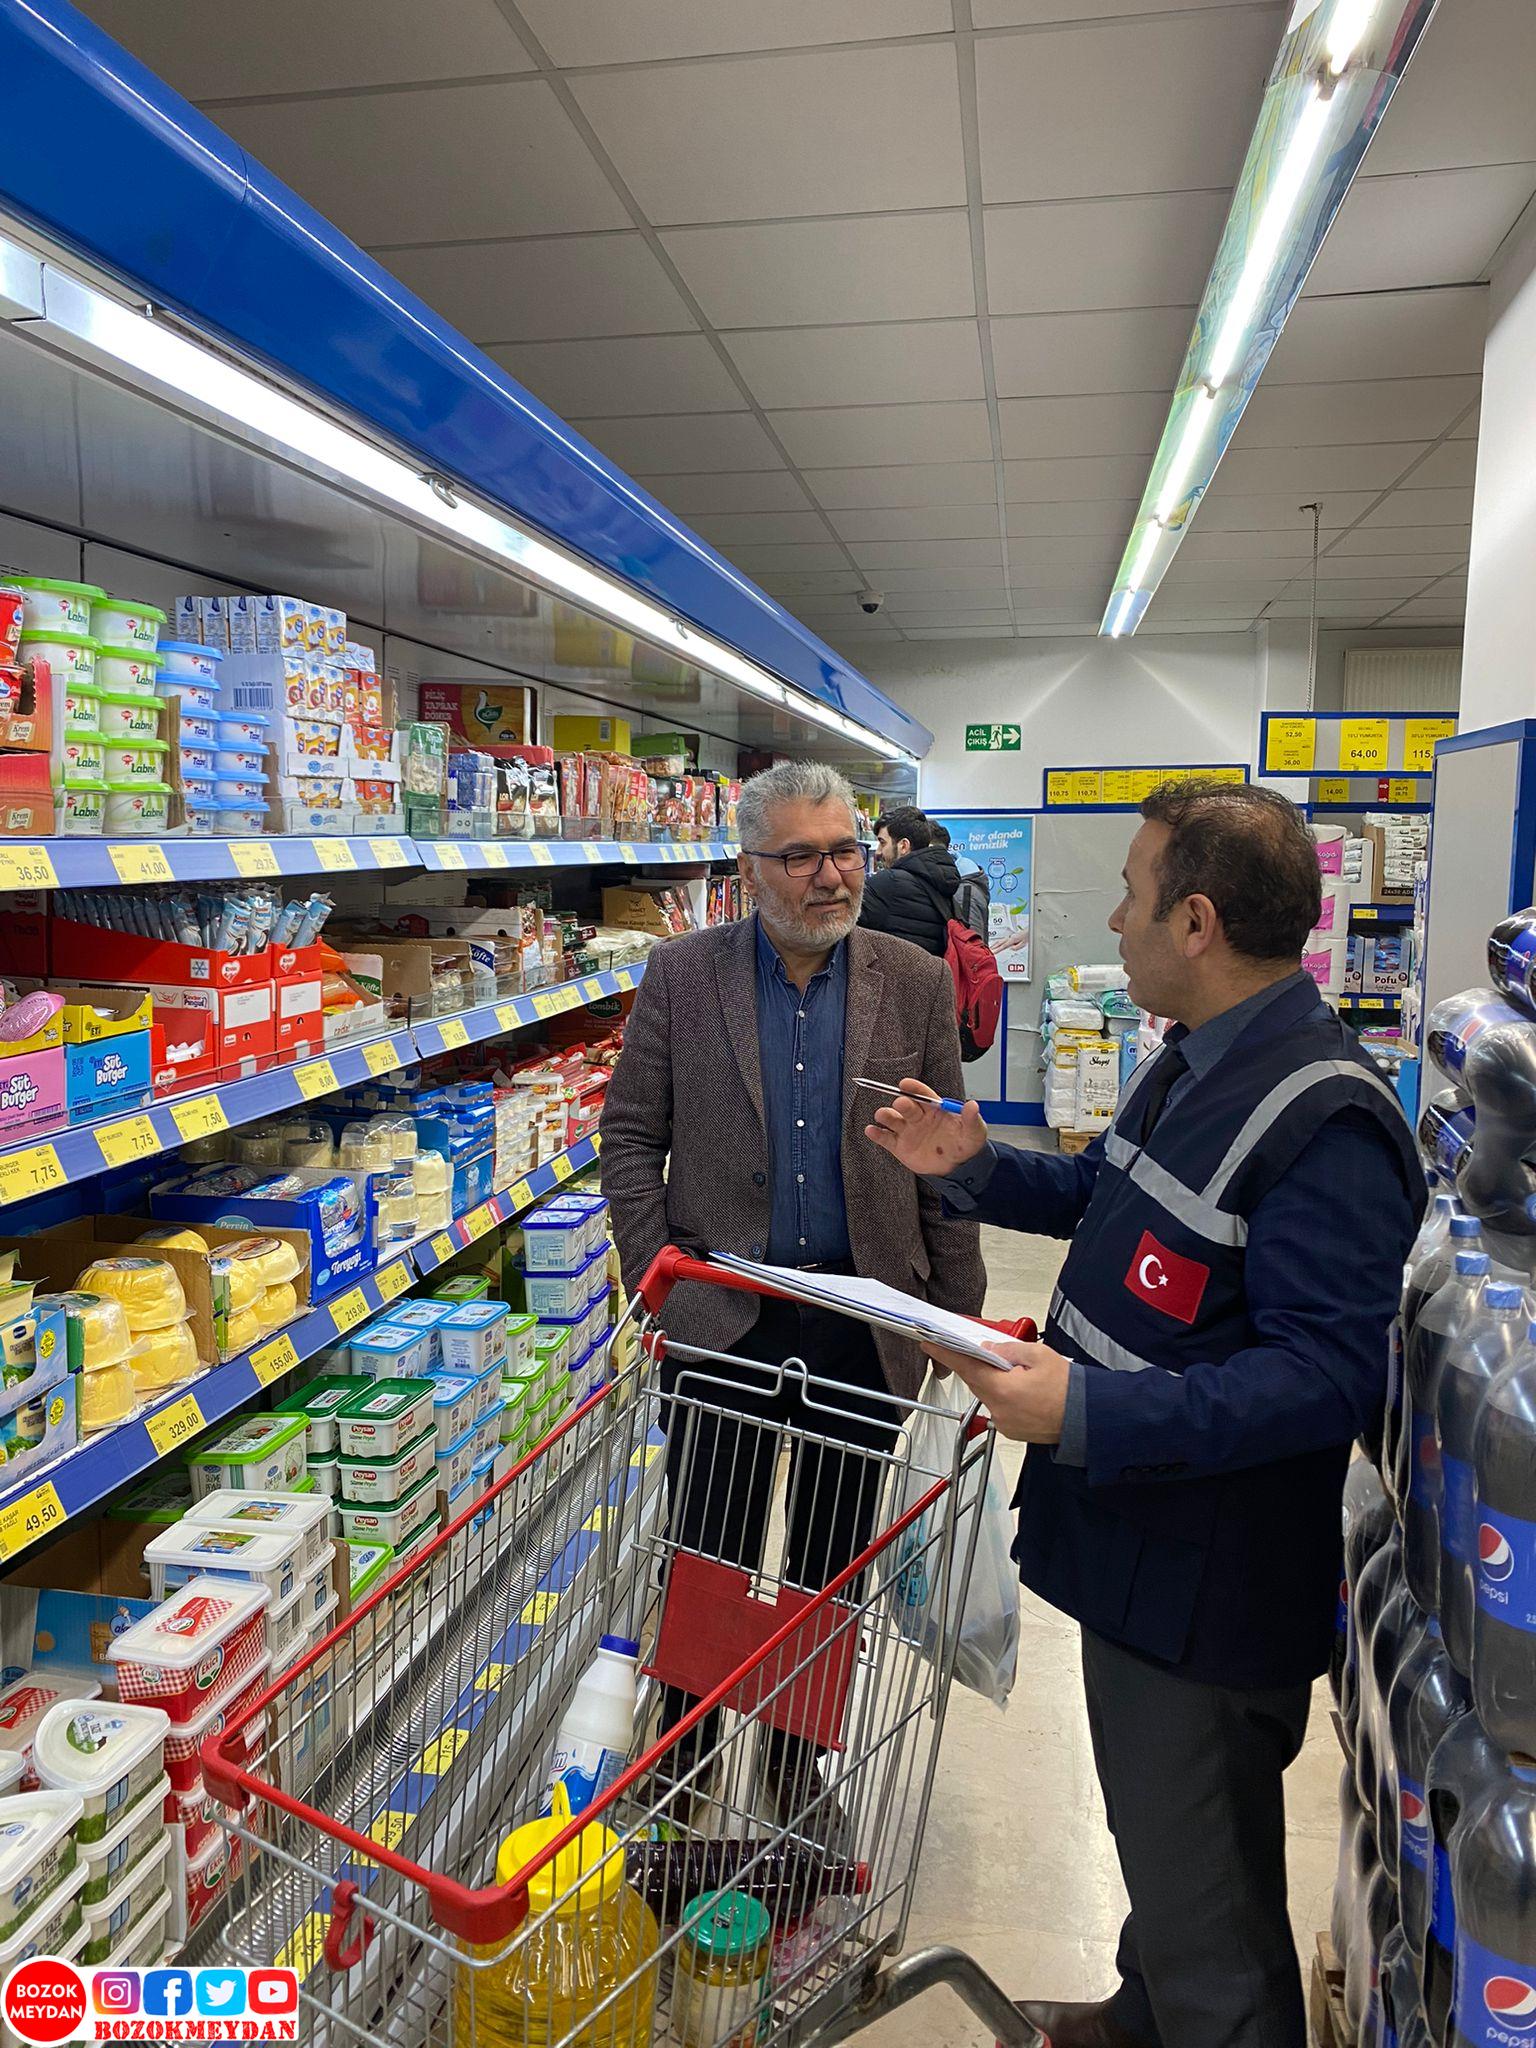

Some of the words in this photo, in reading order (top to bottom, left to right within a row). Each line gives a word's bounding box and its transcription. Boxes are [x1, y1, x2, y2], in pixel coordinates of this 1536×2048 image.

[968, 728, 987, 737] ACİL
[967, 738, 987, 747] ÇIKIŞ
[1350, 749, 1378, 759] 64,00
[76, 757, 101, 768] Labne
[130, 763, 156, 774] Labne
[73, 805, 100, 818] Labne
[141, 807, 164, 818] Labne
[968, 832, 985, 842] her
[988, 829, 1023, 842] alanda
[969, 840, 1009, 851] temizlik
[16, 865, 50, 882] 36,50
[140, 861, 167, 876] 41,00
[361, 981, 381, 992] Köfte
[1374, 975, 1398, 985] Pofu
[103, 1054, 122, 1071] Süt
[96, 1066, 128, 1086] Burger
[319, 1074, 334, 1088] 8,00
[10, 1074, 31, 1094] Süt
[1, 1085, 39, 1110] Burger
[202, 1112, 222, 1129] 7,50
[131, 1132, 154, 1151] 7,75
[30, 1164, 58, 1184] 7,75
[391, 1273, 408, 1289] 87,50
[344, 1302, 367, 1322] 219,00
[269, 1349, 294, 1373] 155,00
[168, 1411, 199, 1440] 329,00
[352, 1425, 376, 1434] Peysan
[353, 1470, 377, 1480] Peysan
[26, 1503, 58, 1532] 49,50
[355, 1515, 379, 1526] Peysan
[201, 1652, 219, 1676] Ekici
[41, 1847, 59, 1874] TAZE
[46, 1913, 63, 1940] TAZE
